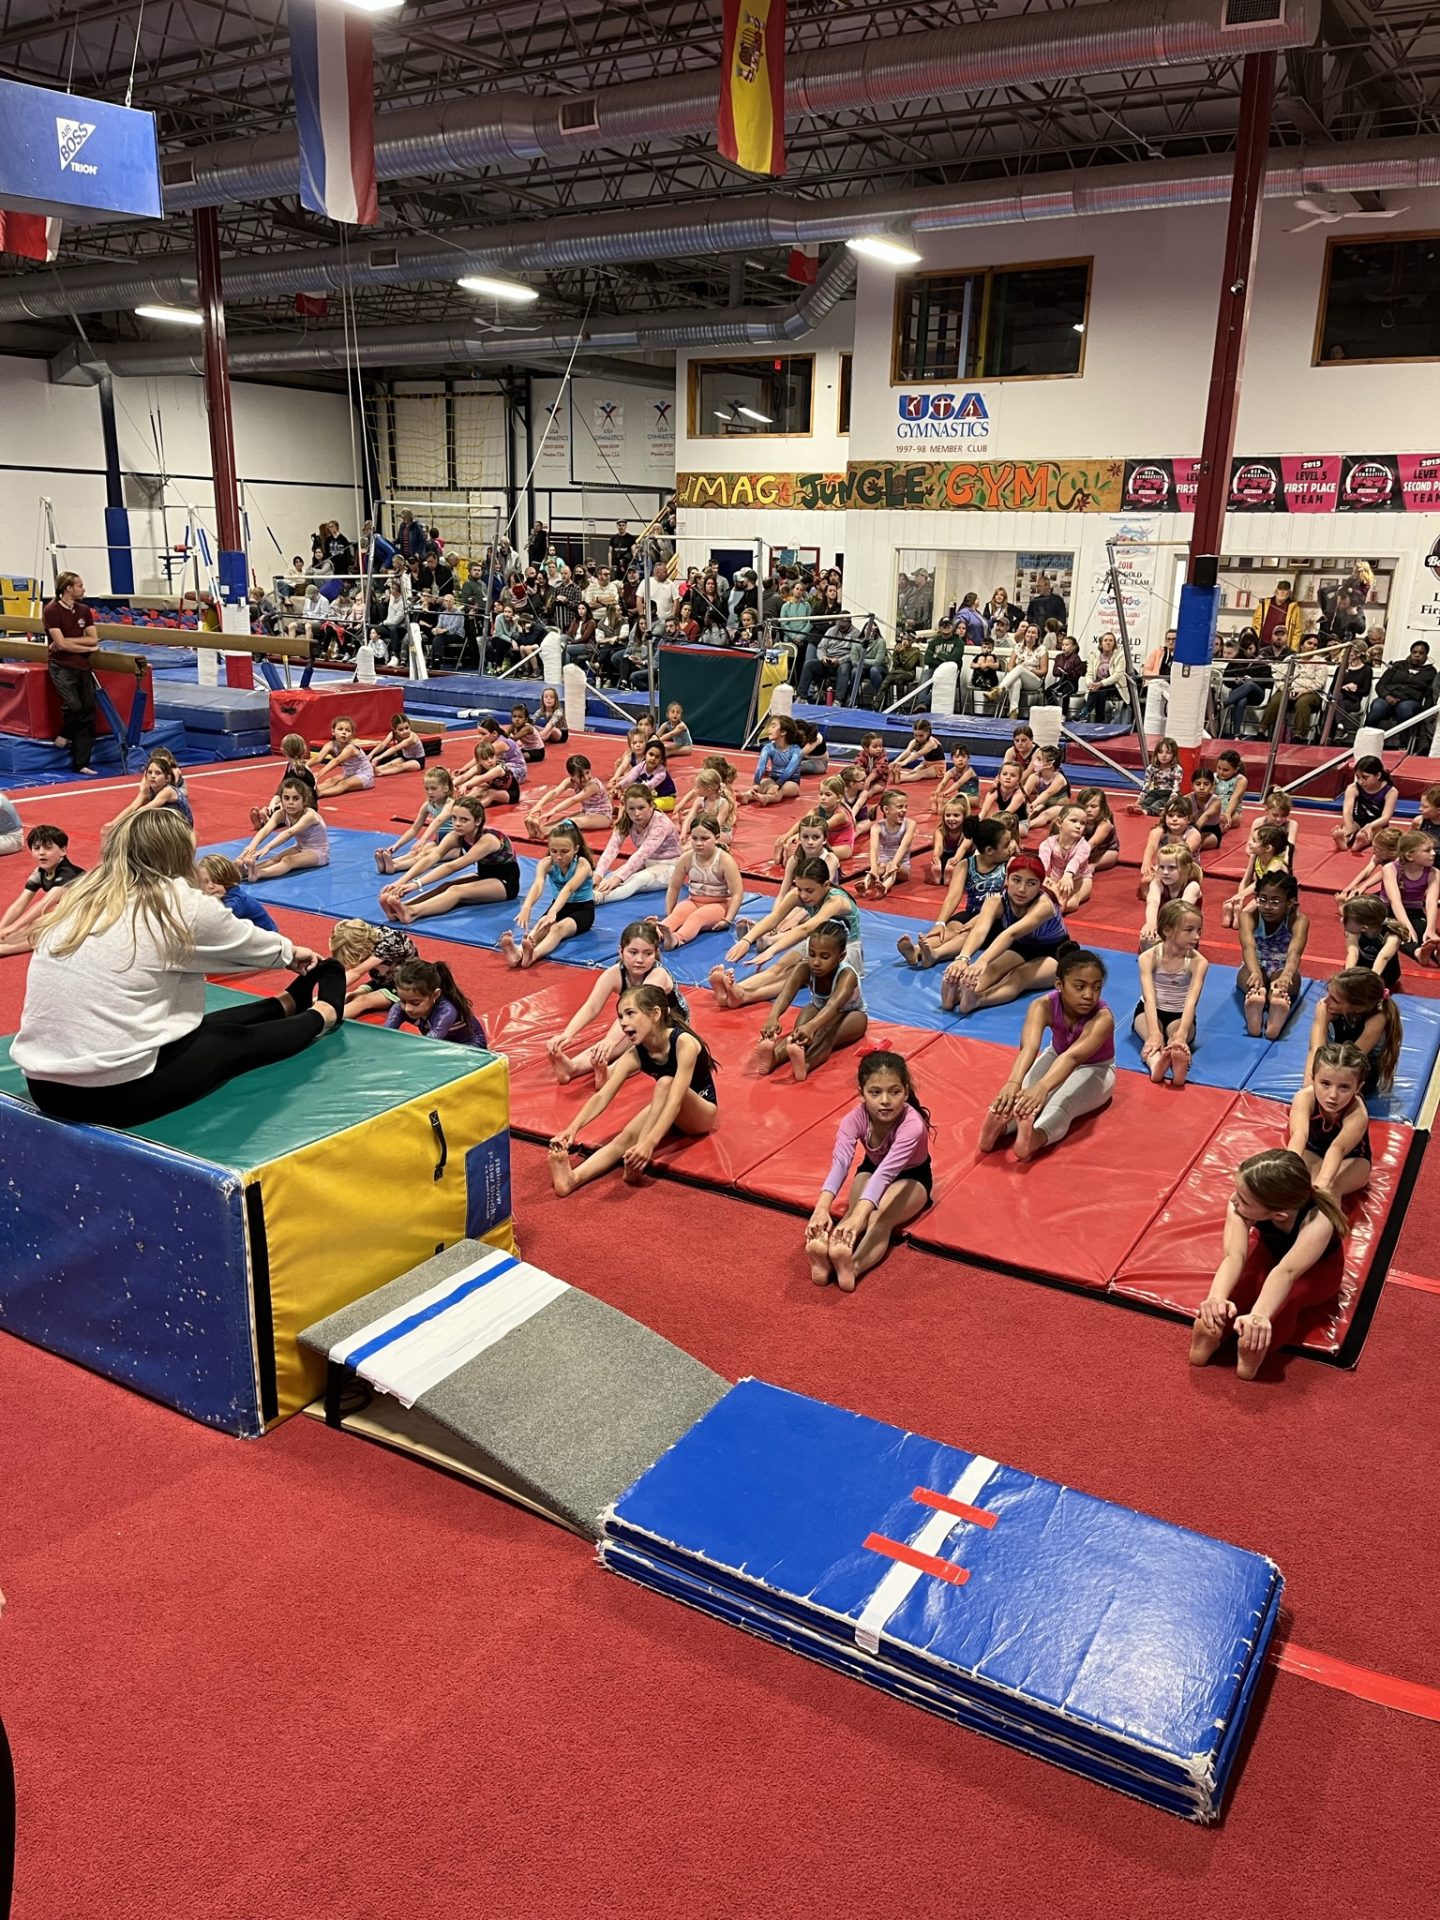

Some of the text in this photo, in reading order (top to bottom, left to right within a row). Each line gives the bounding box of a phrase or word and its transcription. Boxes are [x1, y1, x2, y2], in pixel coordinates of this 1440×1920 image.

[61, 124, 72, 138] AIR
[60, 123, 88, 161] BOSS
[71, 162, 98, 175] TRION
[899, 393, 989, 421] USA
[897, 422, 989, 438] GYMNASTICS
[896, 444, 988, 453] 1997-98 MEMBER CLUB
[1296, 471, 1318, 480] LEVEL
[1413, 469, 1438, 479] LEVEL
[800, 466, 926, 509] JUNGLE
[946, 464, 1050, 507] GYM
[1176, 483, 1198, 494] FIRST
[1284, 482, 1337, 493] FIRST PLACE
[1403, 481, 1432, 492] SECOND
[1295, 494, 1323, 504] TEAM
[1420, 604, 1440, 615] Fir
[1117, 638, 1142, 646] GLD
